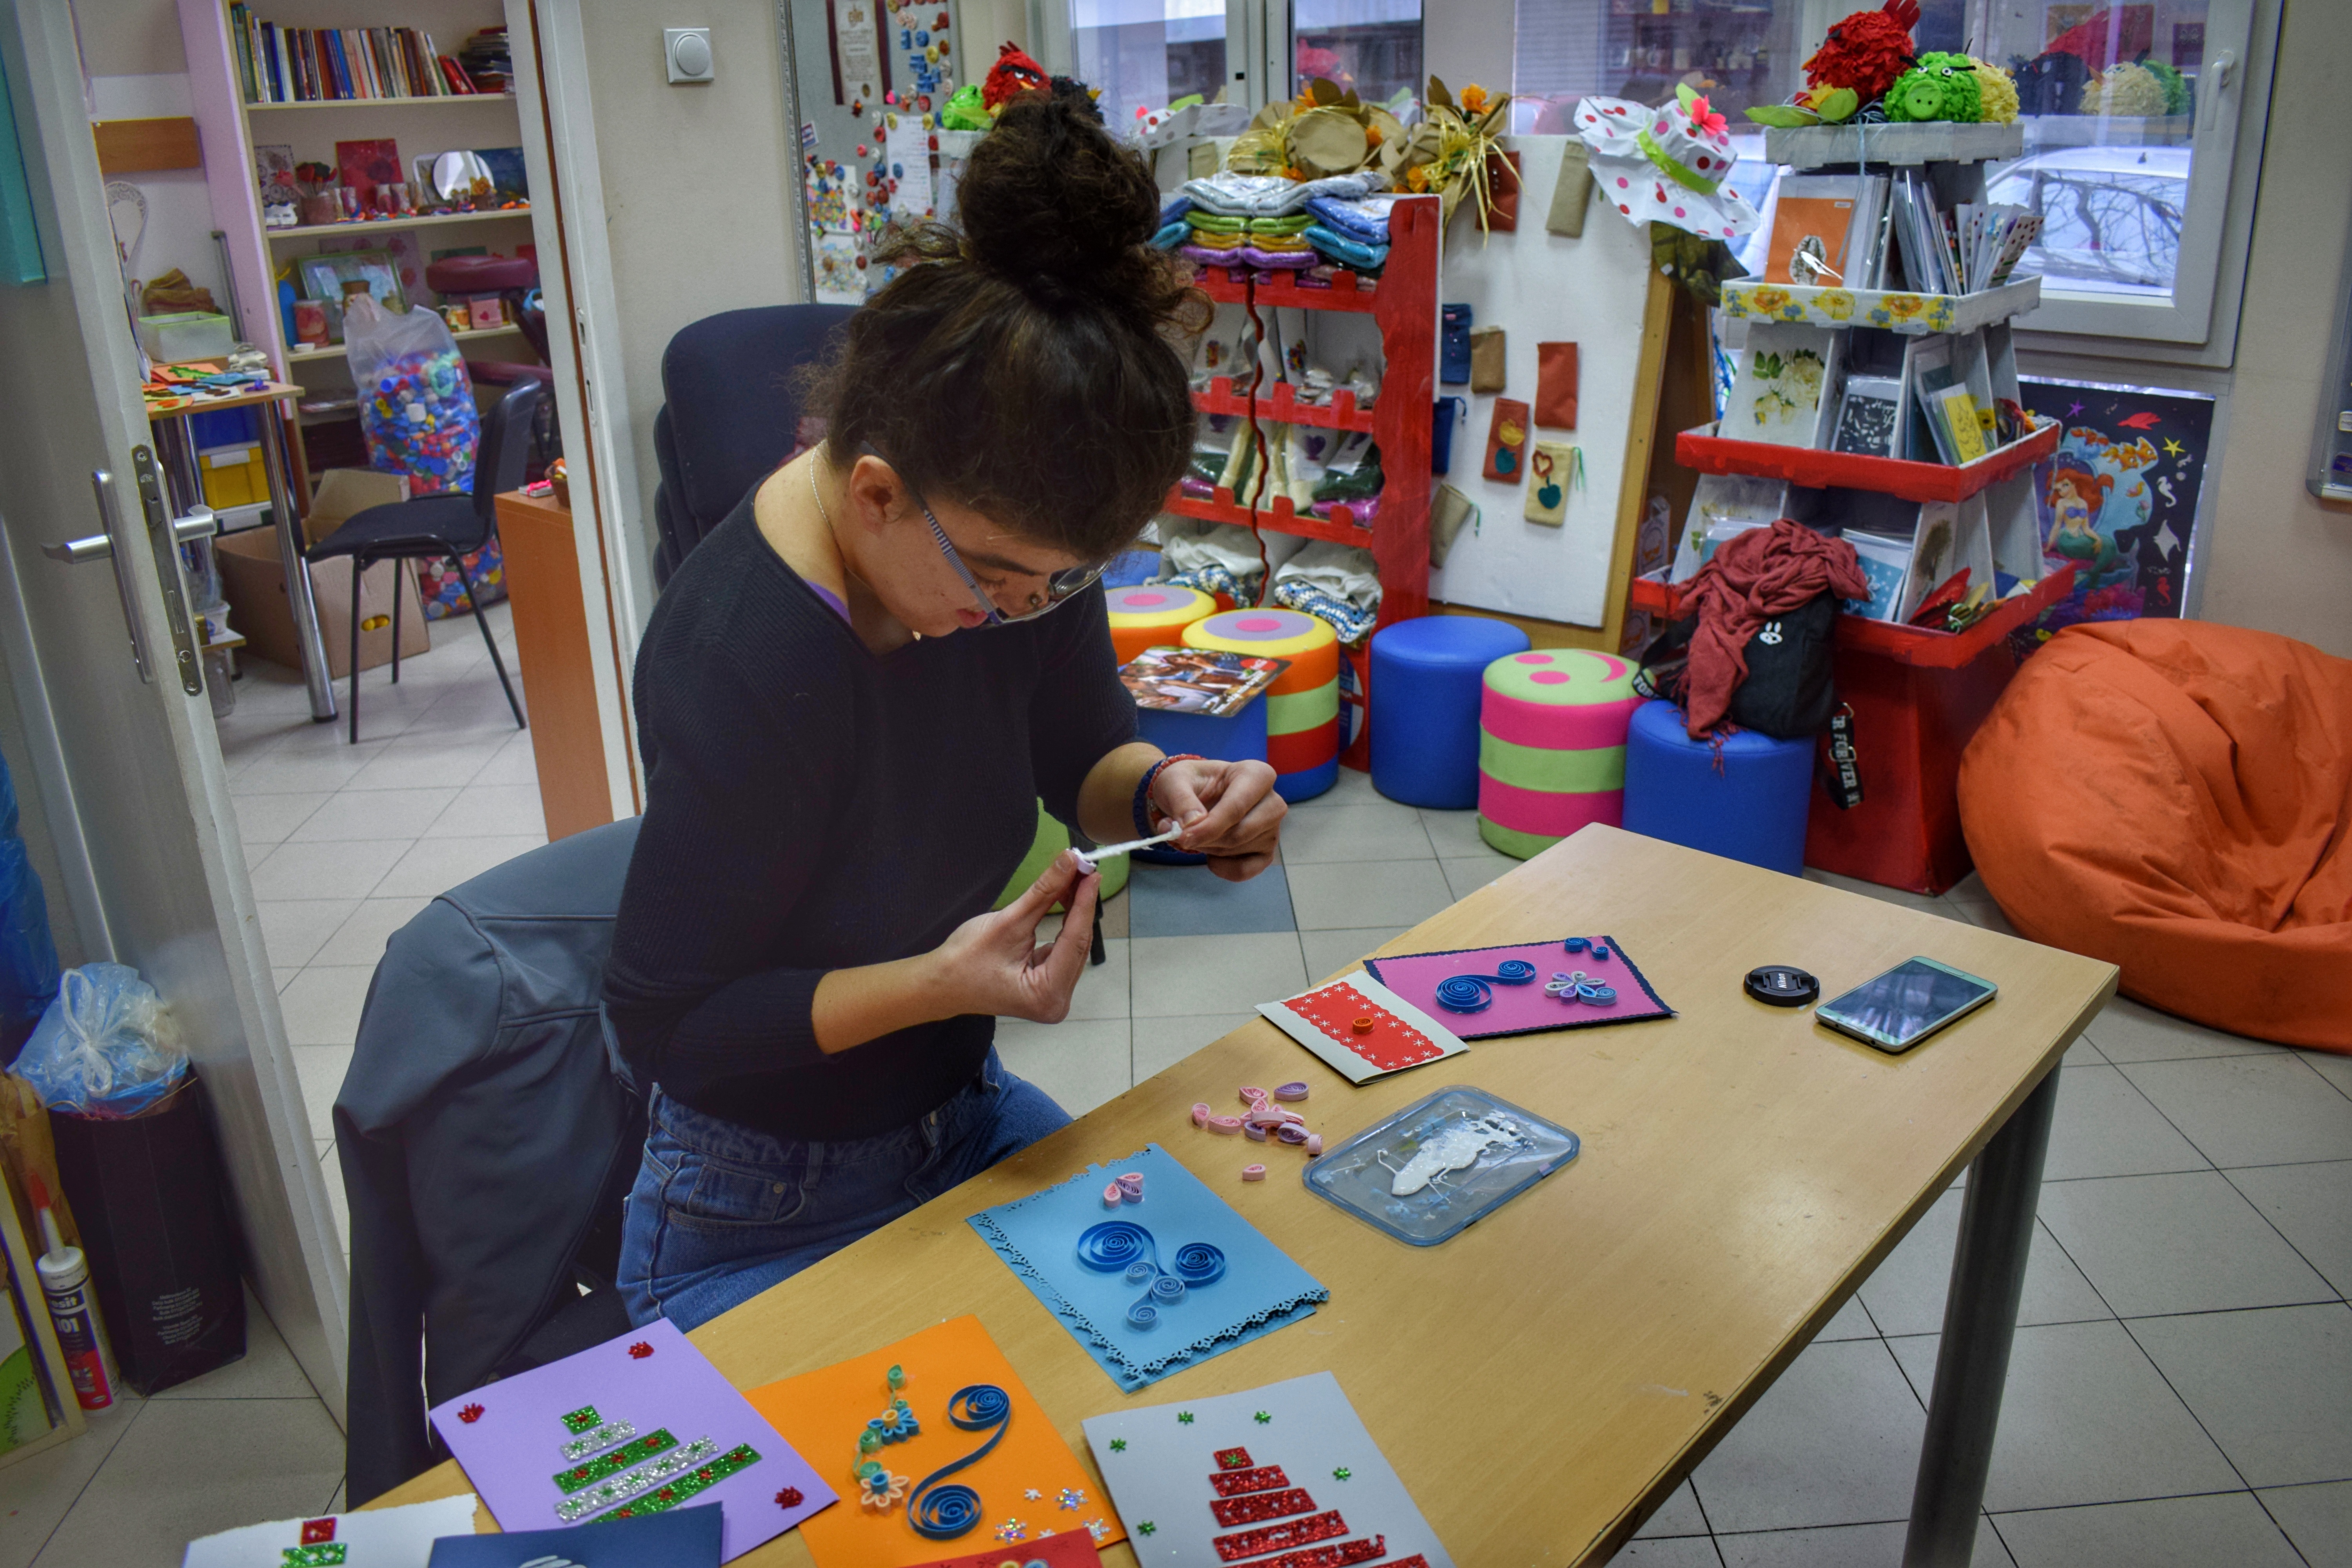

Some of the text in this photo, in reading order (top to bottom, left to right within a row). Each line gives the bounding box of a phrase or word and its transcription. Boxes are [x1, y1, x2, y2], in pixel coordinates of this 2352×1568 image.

[1833, 733, 1857, 788] FORVER
[1777, 973, 1787, 989] Nikon
[49, 1296, 78, 1308] esit
[54, 1317, 80, 1333] 101
